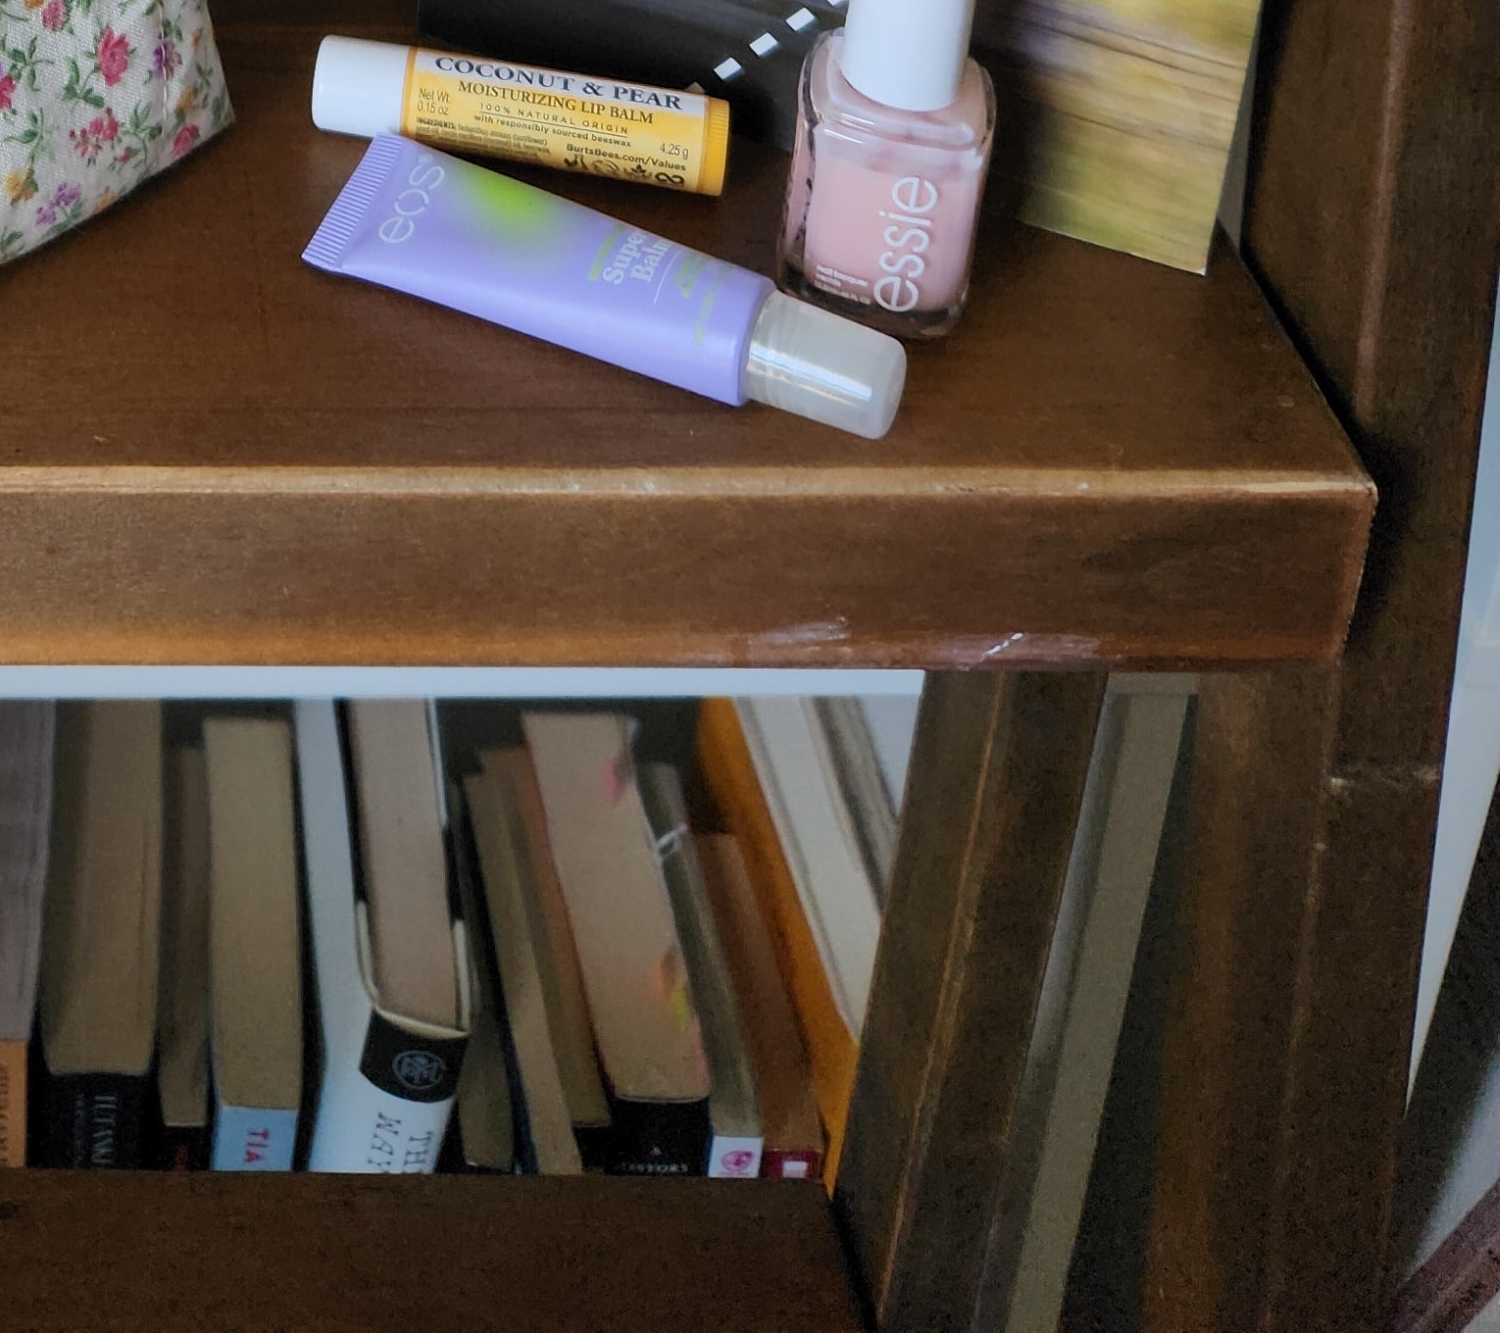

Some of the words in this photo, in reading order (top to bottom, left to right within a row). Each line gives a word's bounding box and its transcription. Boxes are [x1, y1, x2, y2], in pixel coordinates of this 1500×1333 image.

[419, 88, 436, 101] Net
[435, 56, 576, 92] COCONUT
[582, 81, 605, 97] &
[612, 85, 683, 111] PEAR
[416, 101, 436, 114] 0.15
[436, 105, 450, 117] oz
[458, 80, 577, 112] MOISTURIZING
[580, 100, 606, 116] LIP
[610, 106, 655, 125] BALM
[480, 102, 510, 114] 100%
[518, 108, 576, 126] NATURAL
[582, 120, 629, 135] ORIGIN
[474, 113, 494, 124] with
[496, 117, 550, 135] responsibly
[552, 127, 589, 141] sourced
[591, 132, 632, 148] beeswax
[566, 143, 687, 171] BurtsBees.com/Values
[660, 142, 681, 156] 4.25
[682, 148, 690, 160] g
[873, 176, 938, 313] essie
